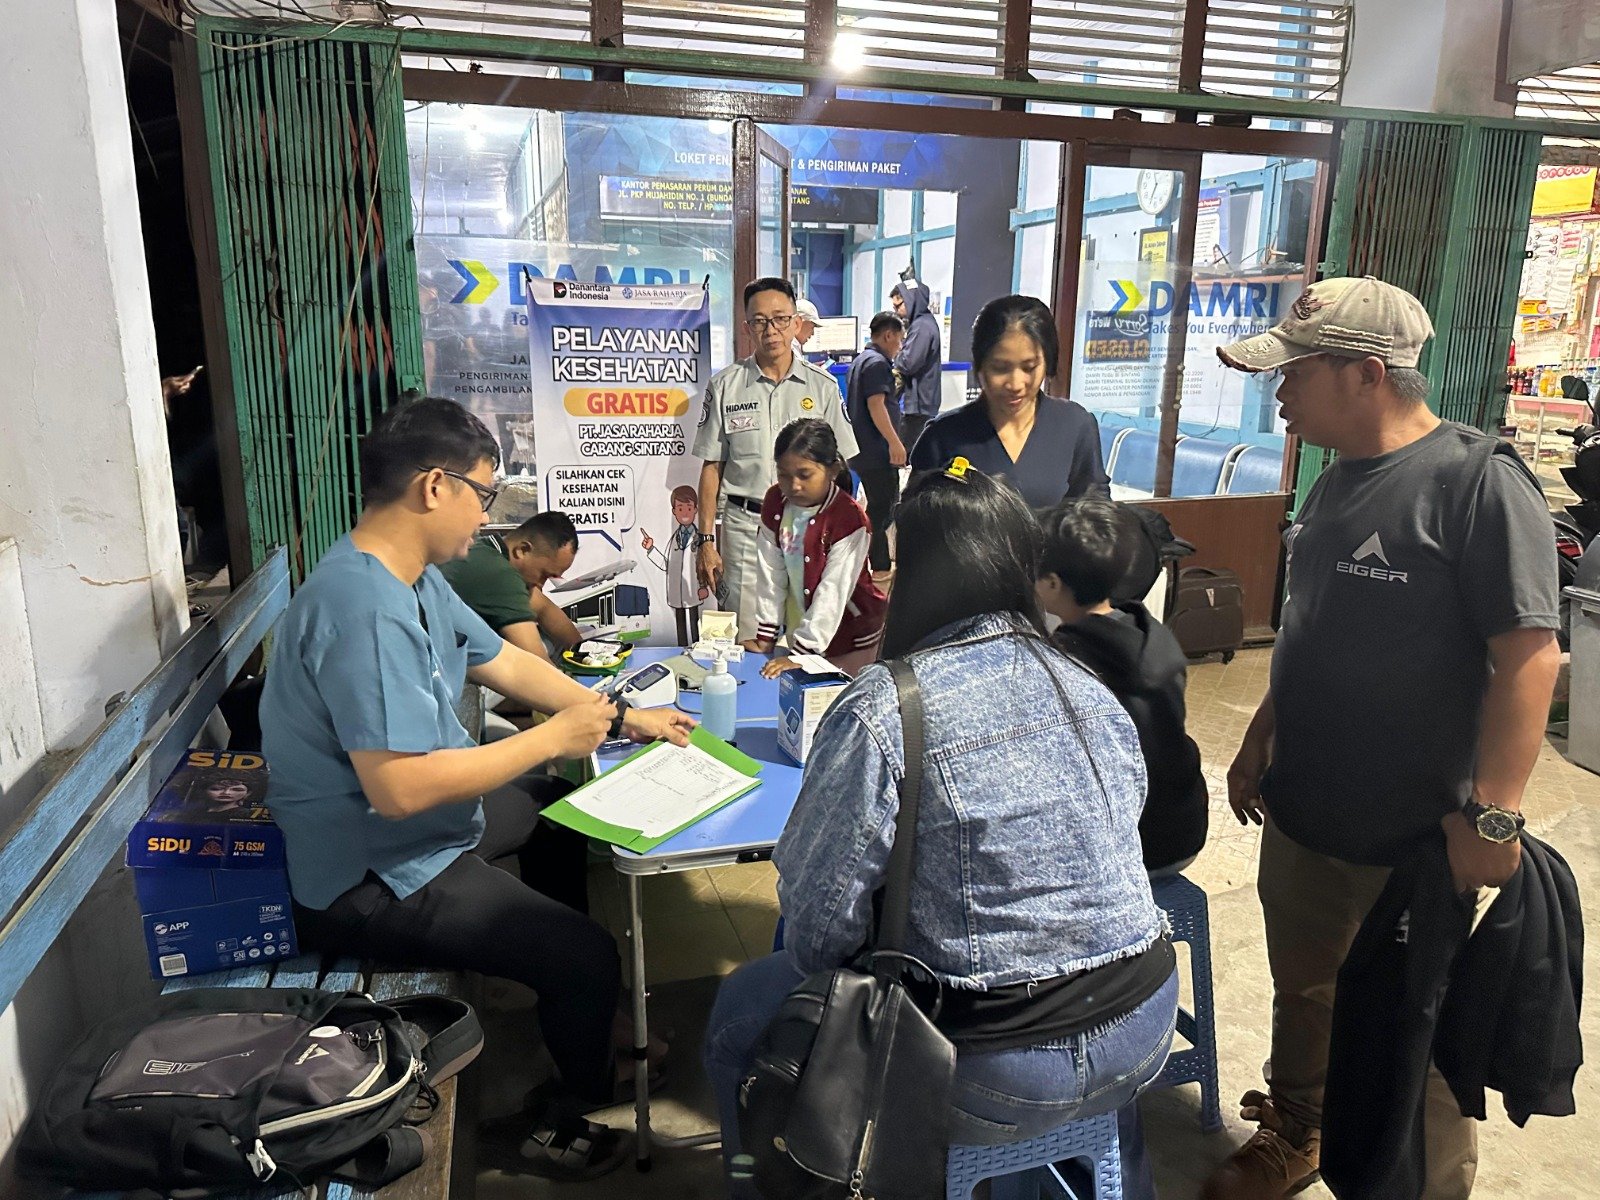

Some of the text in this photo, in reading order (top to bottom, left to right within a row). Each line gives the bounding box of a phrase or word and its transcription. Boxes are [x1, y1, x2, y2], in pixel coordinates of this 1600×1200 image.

[674, 152, 706, 164] LOKET
[798, 159, 805, 169] &
[808, 160, 869, 173] PENGIRIMAN
[871, 163, 901, 174] PAKET
[621, 181, 650, 190] KANTOR
[652, 182, 691, 191] PEMASARAN
[694, 184, 717, 192] PERUM
[618, 190, 628, 198] JL.
[645, 191, 684, 200] MUJAHIDIN
[700, 193, 704, 201] 1
[663, 201, 676, 209] NO.
[679, 202, 696, 210] TELP.
[569, 282, 611, 292] Danantara
[569, 291, 609, 301] Indonesia
[634, 289, 651, 298] JASA
[1150, 280, 1280, 317] DAMRI
[552, 326, 700, 353] PELAYANAN
[553, 356, 698, 383] KESEHATAN
[459, 372, 528, 381] PENGIRIMAN
[587, 392, 668, 414] GRATIS
[725, 402, 758, 413] HIDAYAT
[598, 424, 629, 438] JASA
[629, 424, 684, 438] RAHARJA
[581, 441, 685, 456] CABANG SINTANG
[556, 469, 626, 479] SILAHKAN CEK
[562, 483, 618, 493] KESEHATAN
[559, 497, 625, 507] KALIAN DISINI
[568, 513, 608, 524] GRATIS
[1336, 561, 1408, 583] EIGER
[187, 752, 264, 770] SiD
[234, 841, 265, 852] 75 GSM
[170, 921, 189, 931] APP
